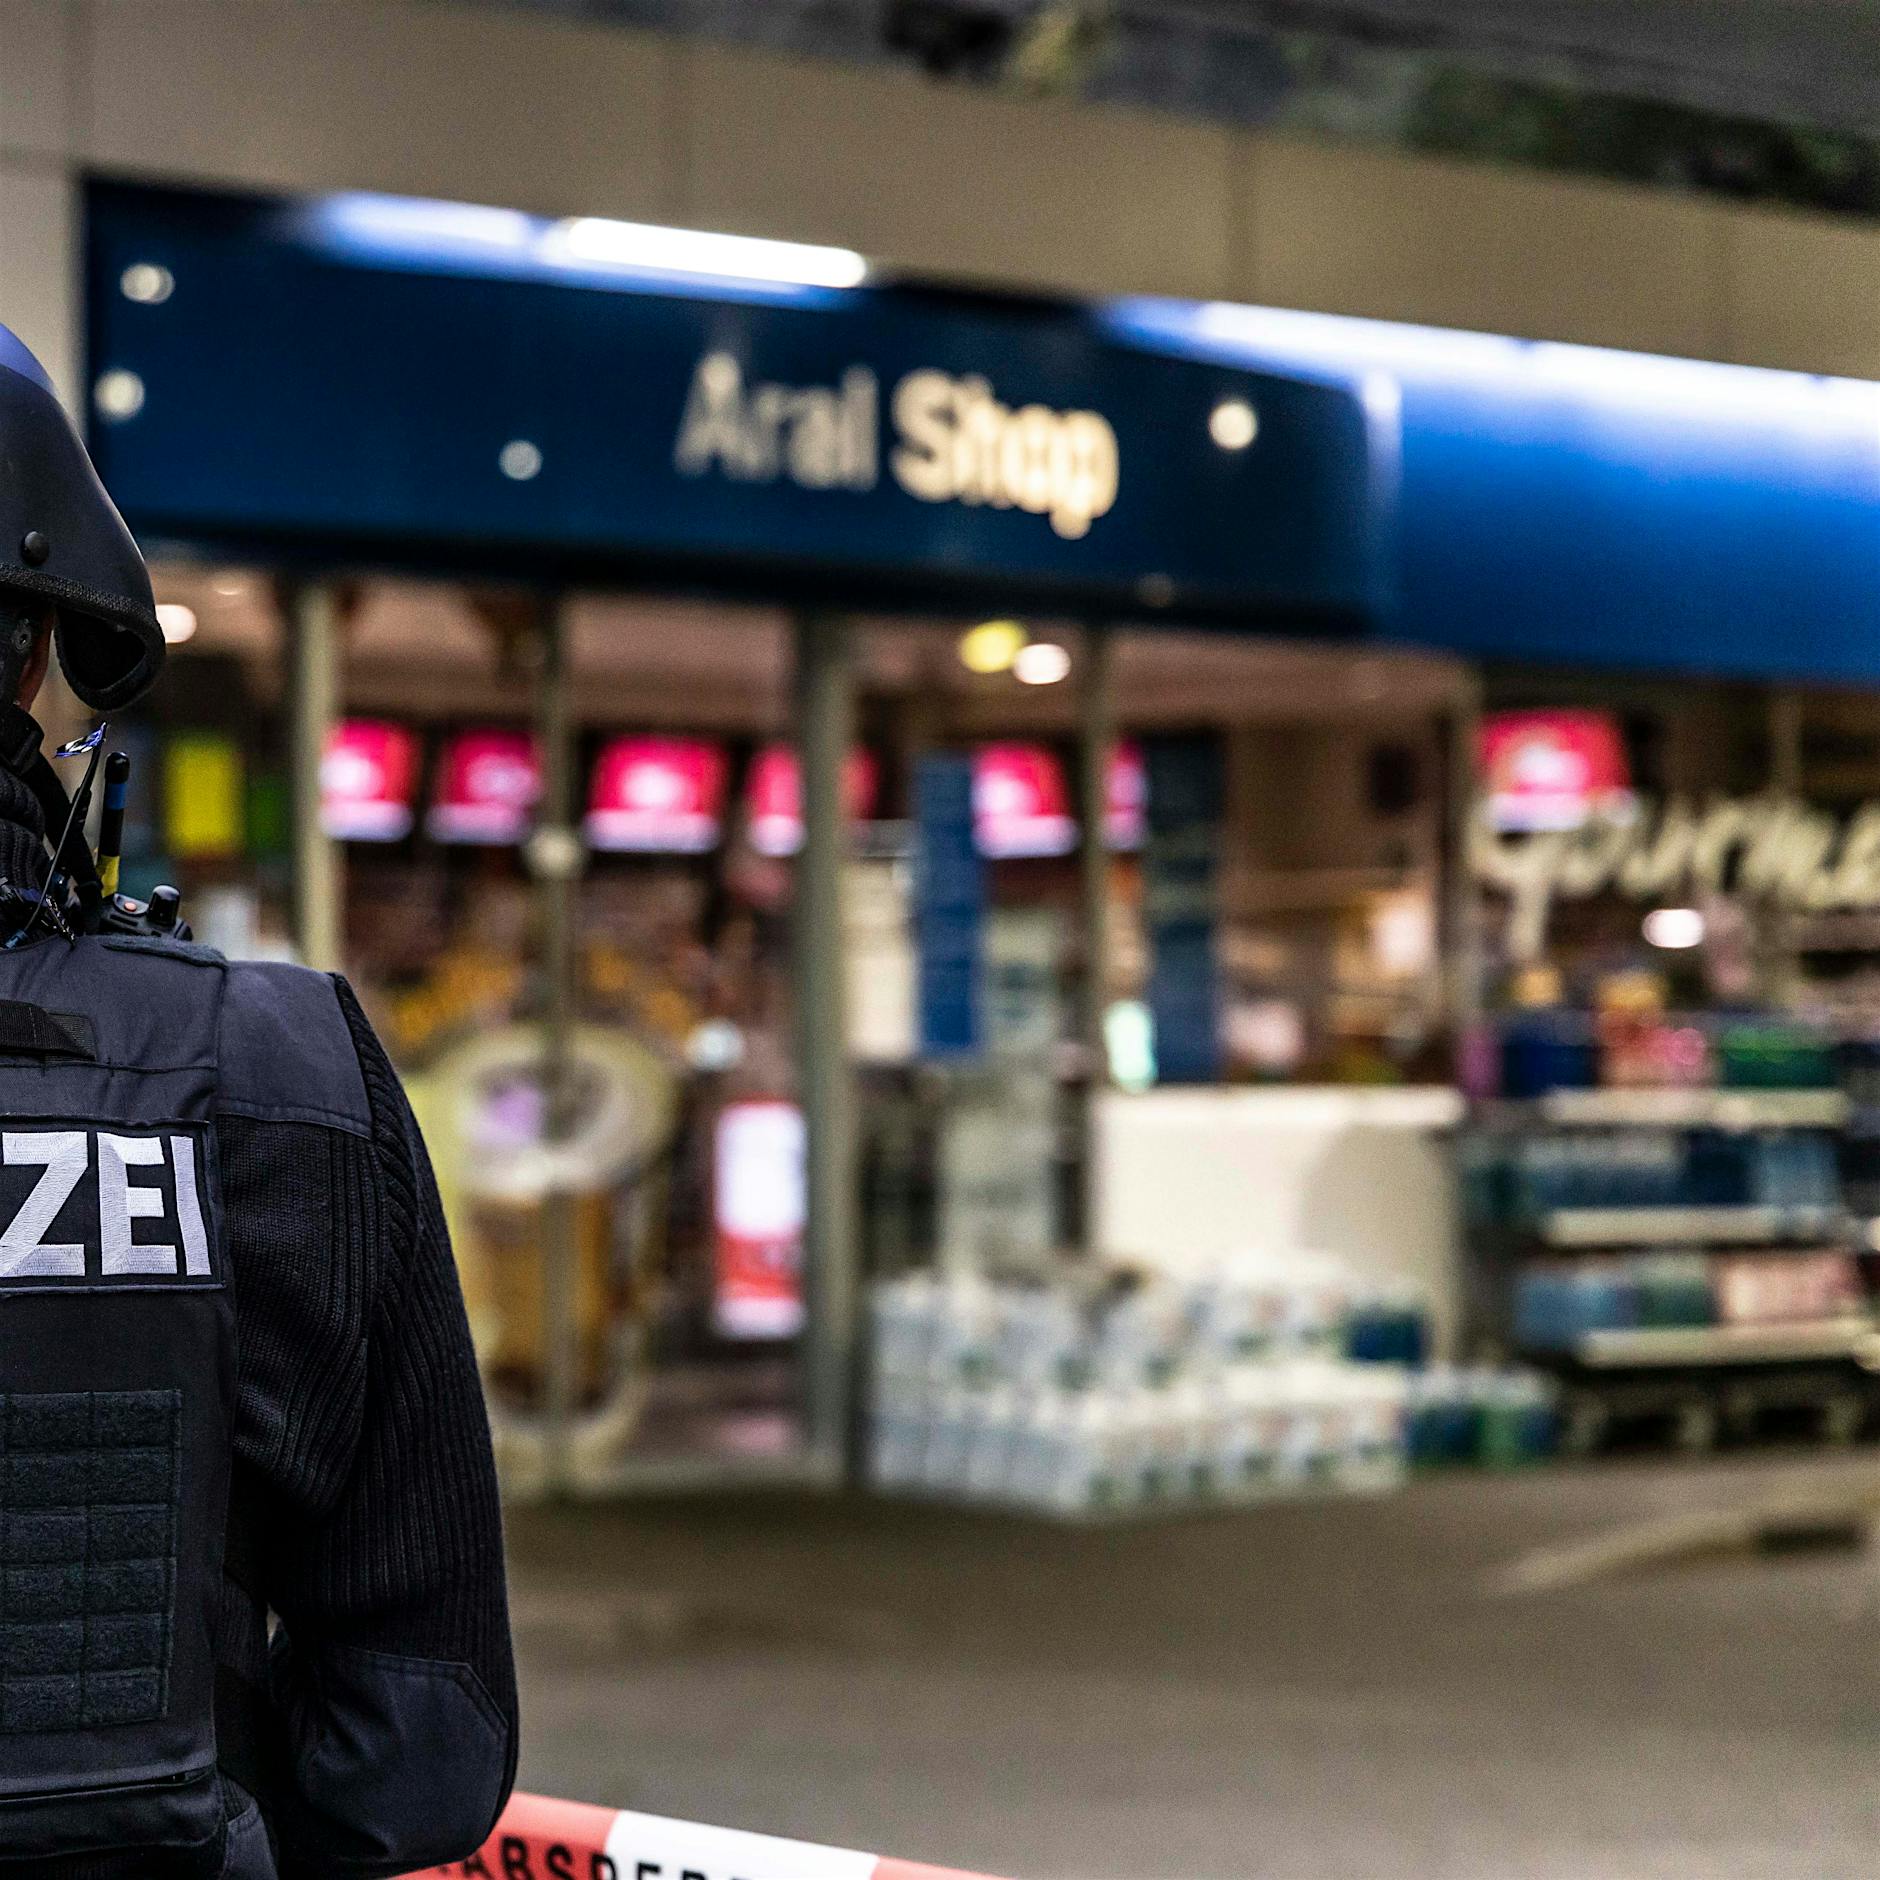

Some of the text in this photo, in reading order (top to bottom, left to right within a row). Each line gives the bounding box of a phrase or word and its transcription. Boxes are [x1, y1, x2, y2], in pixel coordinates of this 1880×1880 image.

[673, 352, 1121, 541] Aral Shop
[0, 1131, 212, 1277] ZEI
